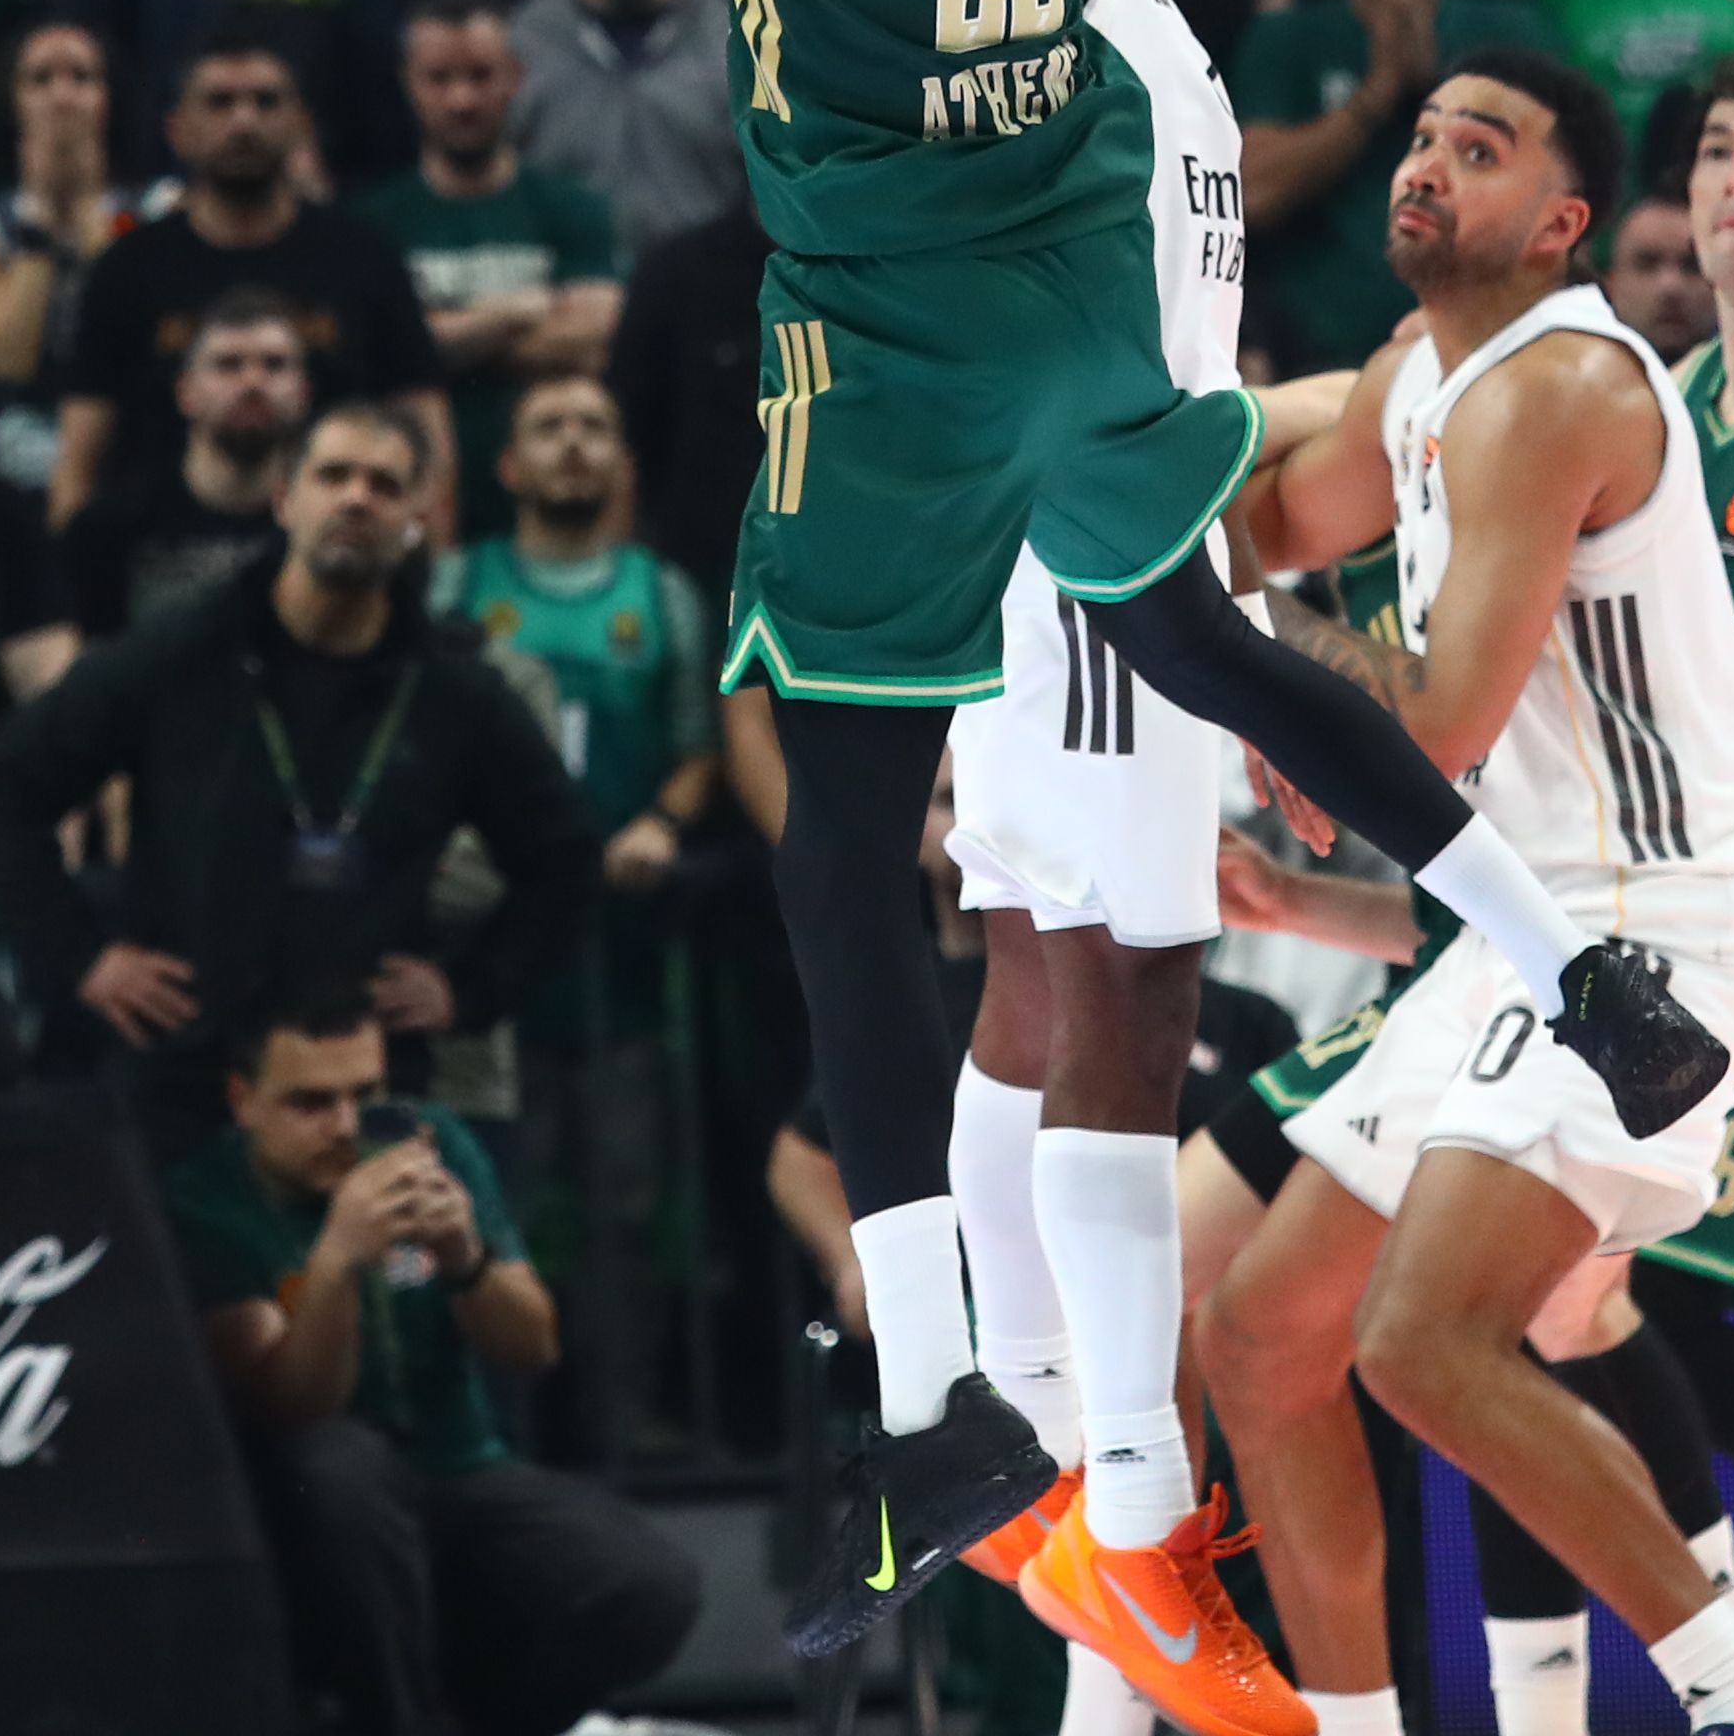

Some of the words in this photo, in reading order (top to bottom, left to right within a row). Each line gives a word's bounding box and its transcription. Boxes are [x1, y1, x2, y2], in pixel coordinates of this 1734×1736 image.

[921, 39, 1079, 144] ATHEN
[1182, 154, 1239, 221] Em
[1471, 1006, 1535, 1083] 0
